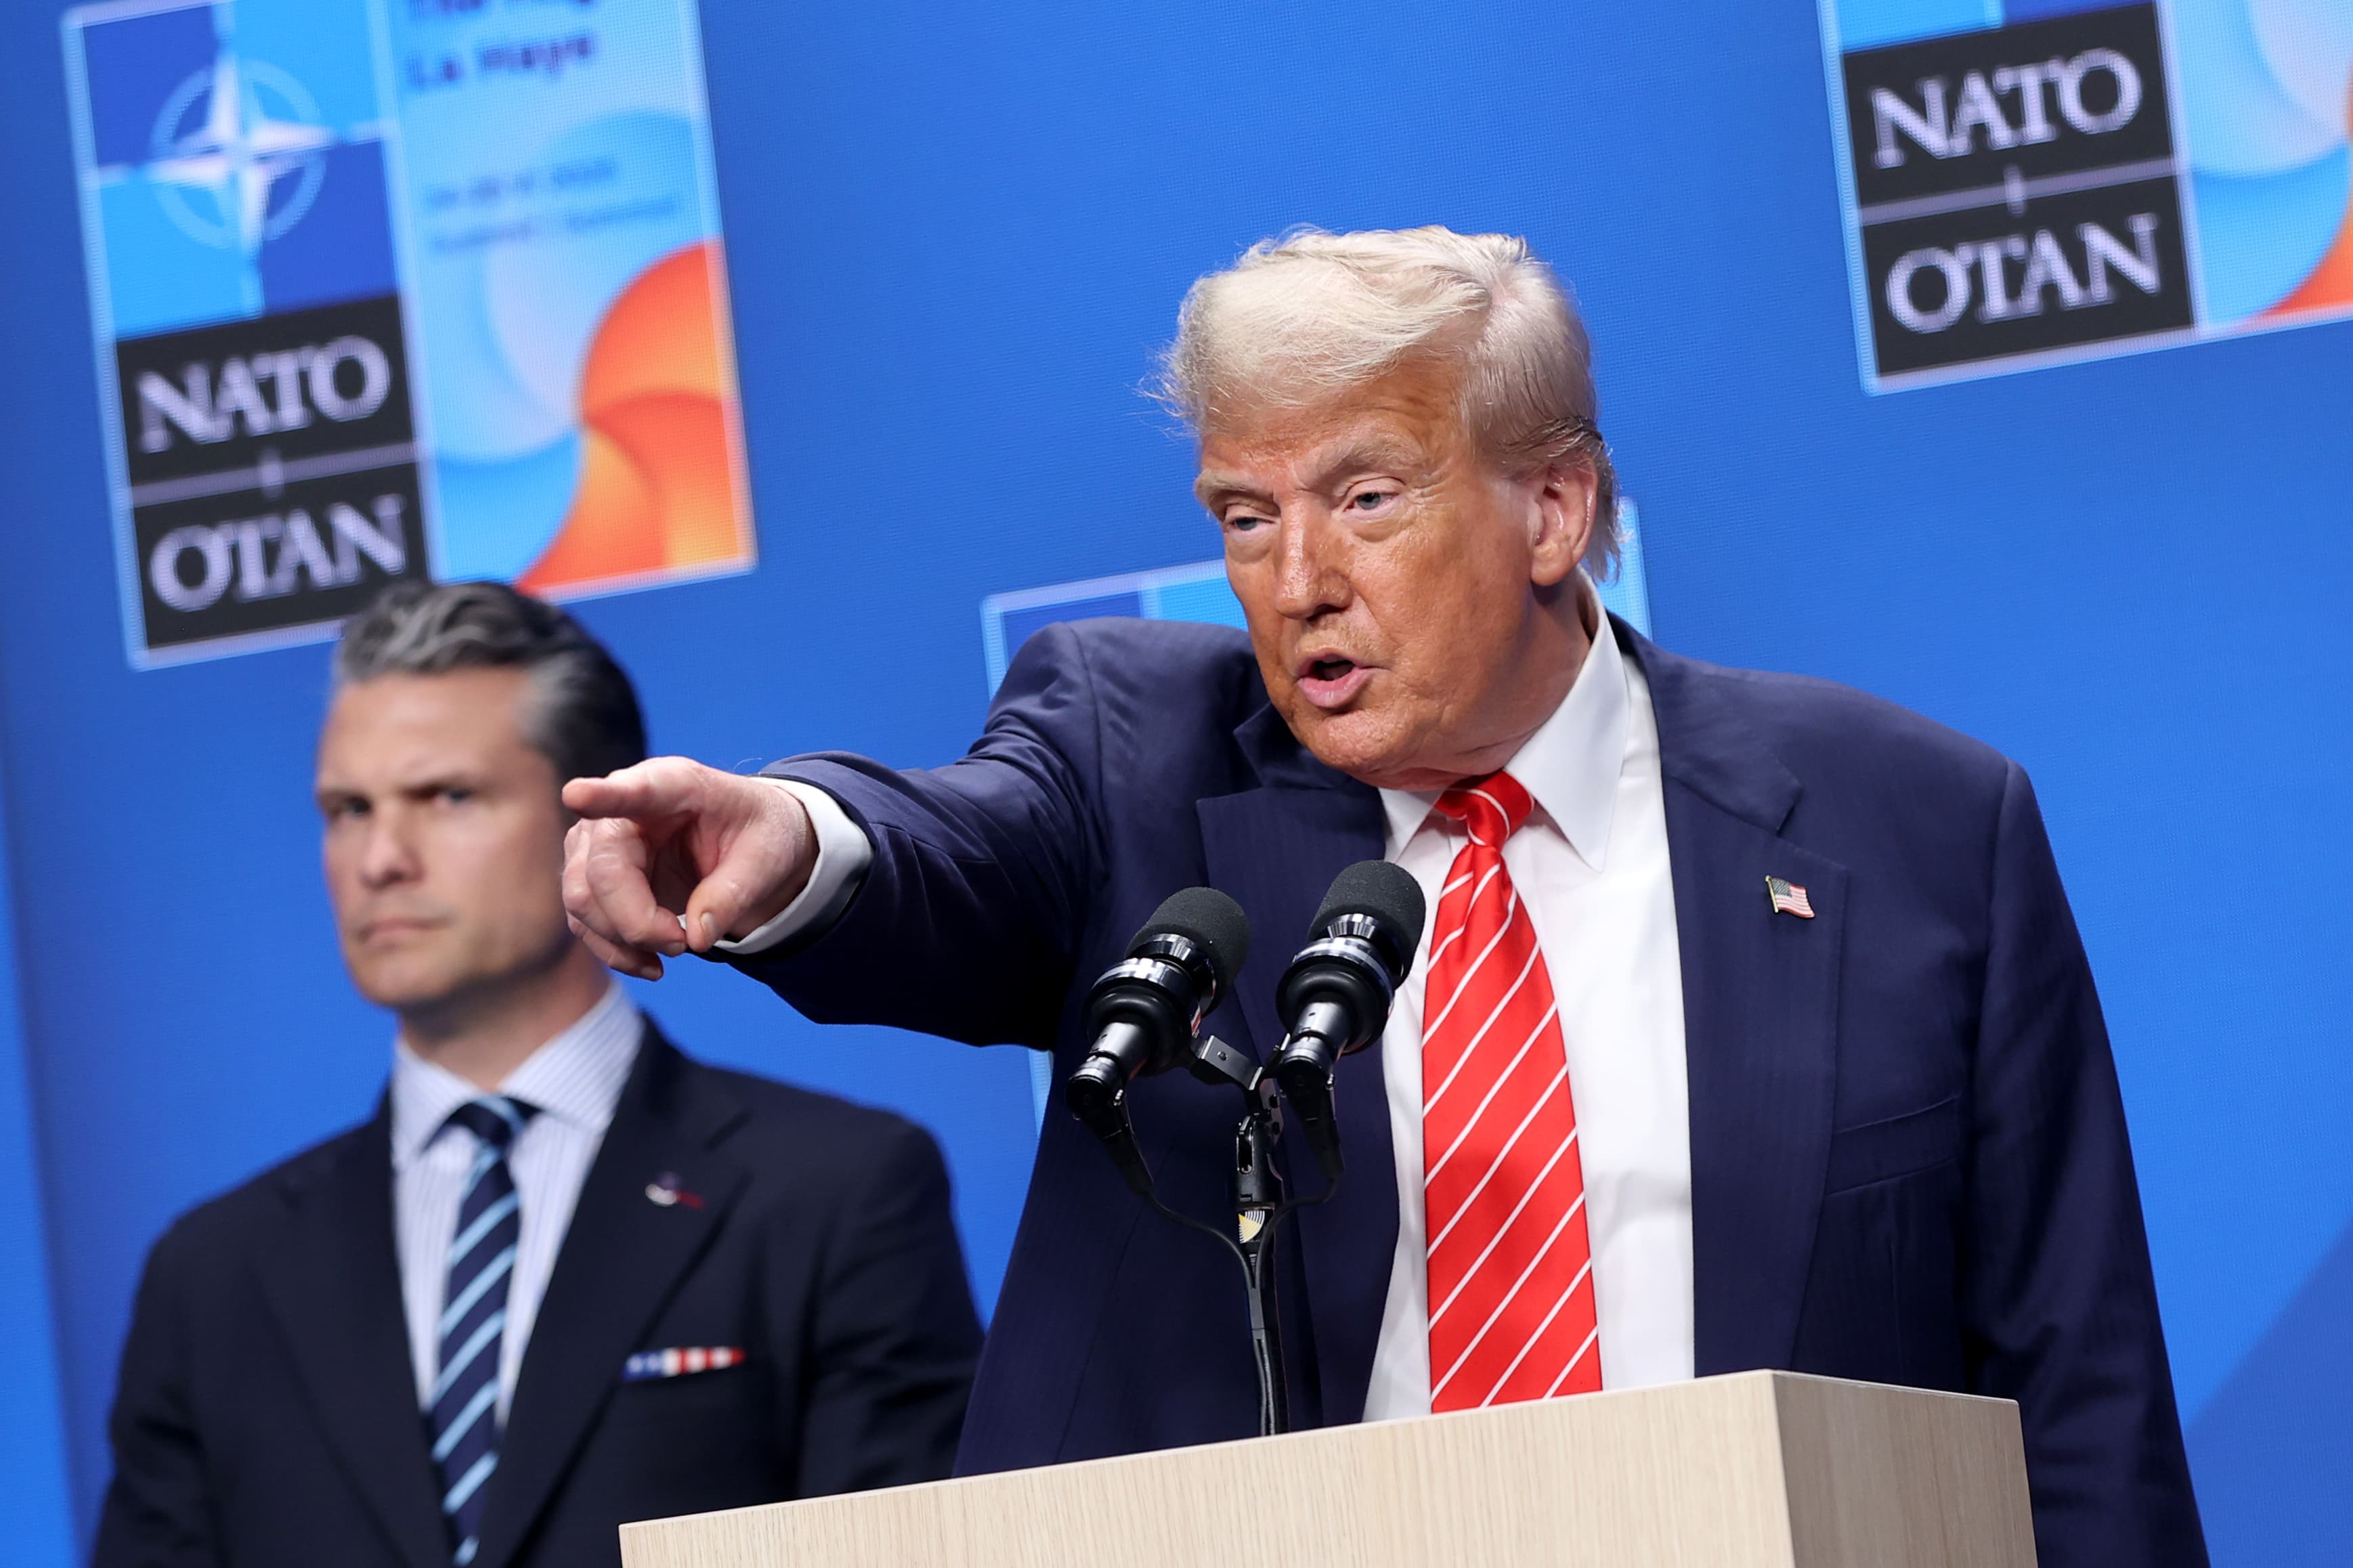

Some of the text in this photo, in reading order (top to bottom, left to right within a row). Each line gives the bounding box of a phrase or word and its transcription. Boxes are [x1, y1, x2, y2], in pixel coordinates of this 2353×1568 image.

[1869, 47, 2142, 168] NATO
[1885, 212, 2160, 334] OTAN
[137, 334, 391, 454] NATO
[149, 493, 406, 612] OTAN
